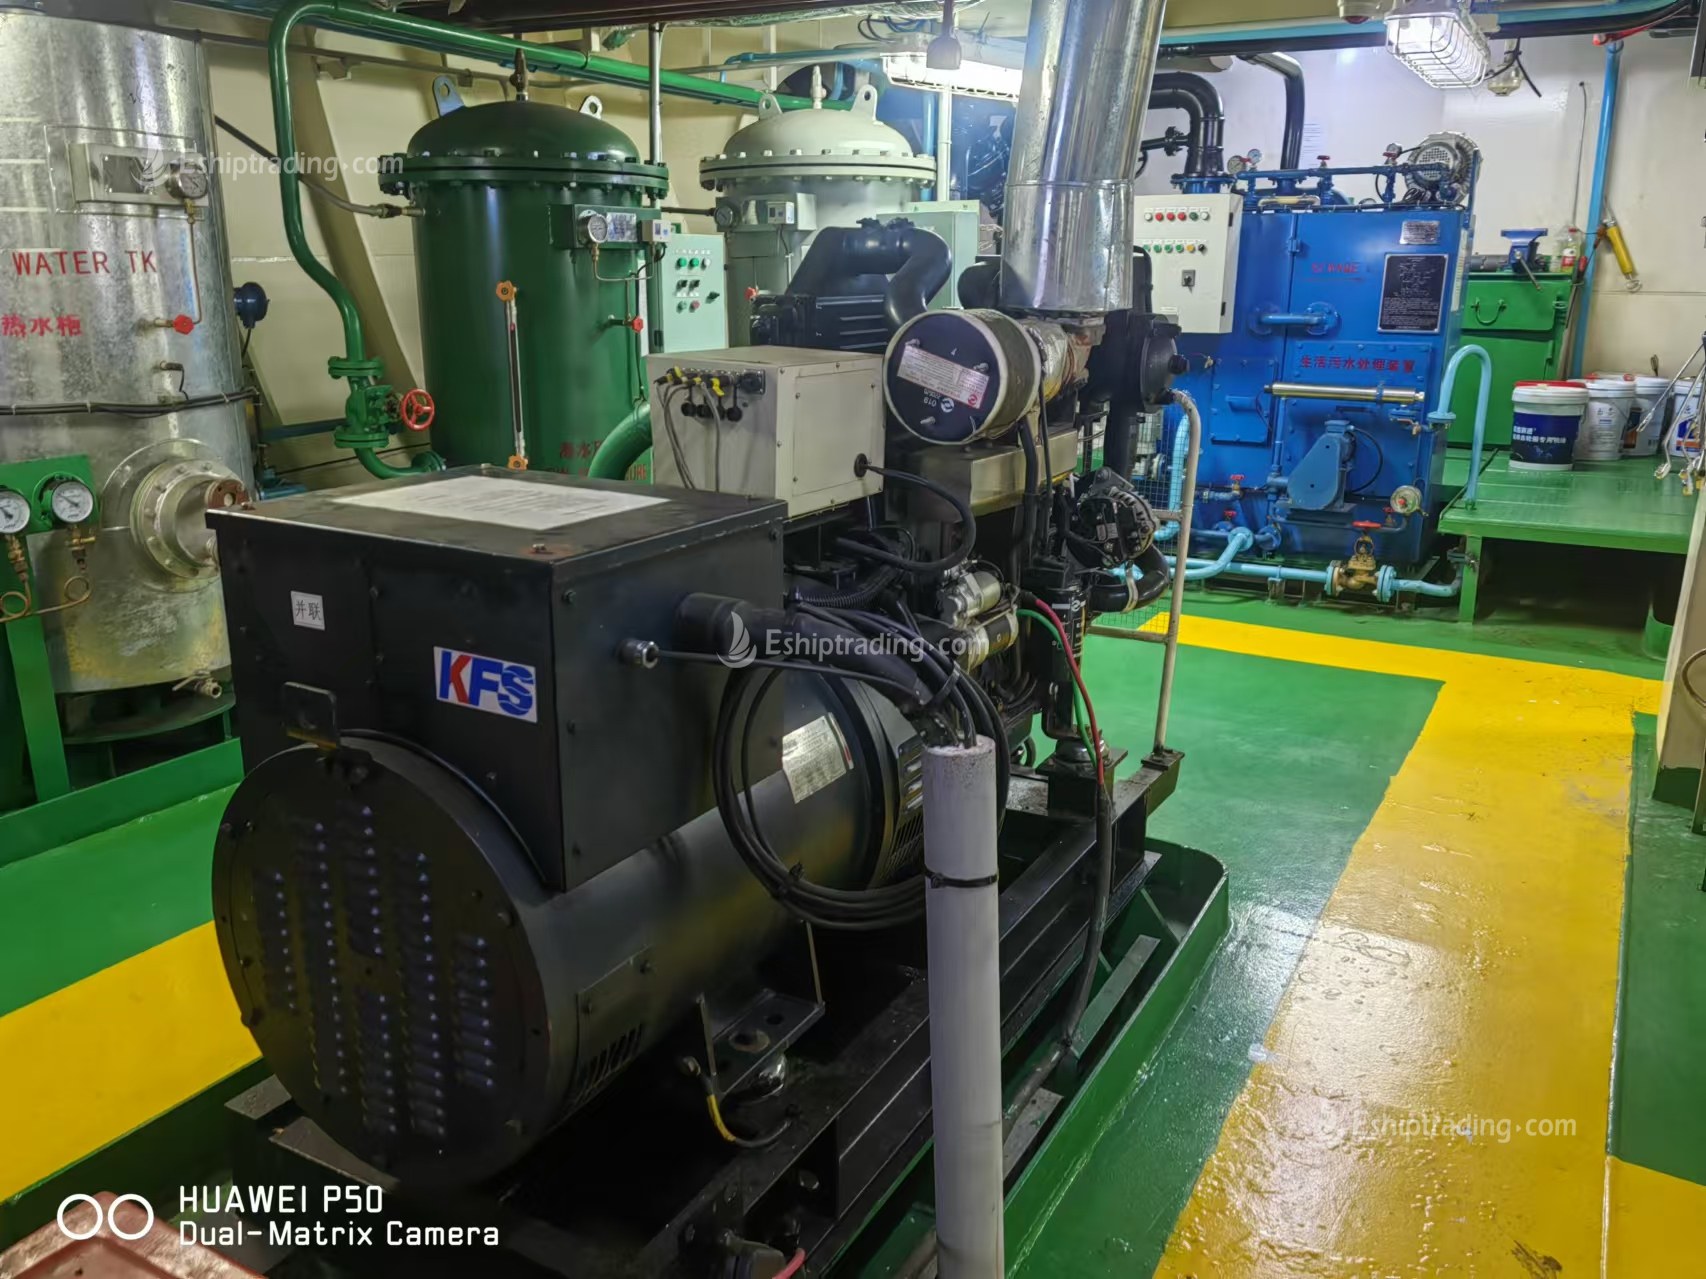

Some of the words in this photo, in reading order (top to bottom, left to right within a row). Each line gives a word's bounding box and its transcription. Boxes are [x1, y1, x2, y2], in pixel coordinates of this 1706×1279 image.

[12, 251, 110, 276] WATER
[125, 250, 157, 274] TK
[2, 313, 82, 338] 热水柜
[295, 599, 321, 621] 并联
[439, 650, 534, 716] KFS
